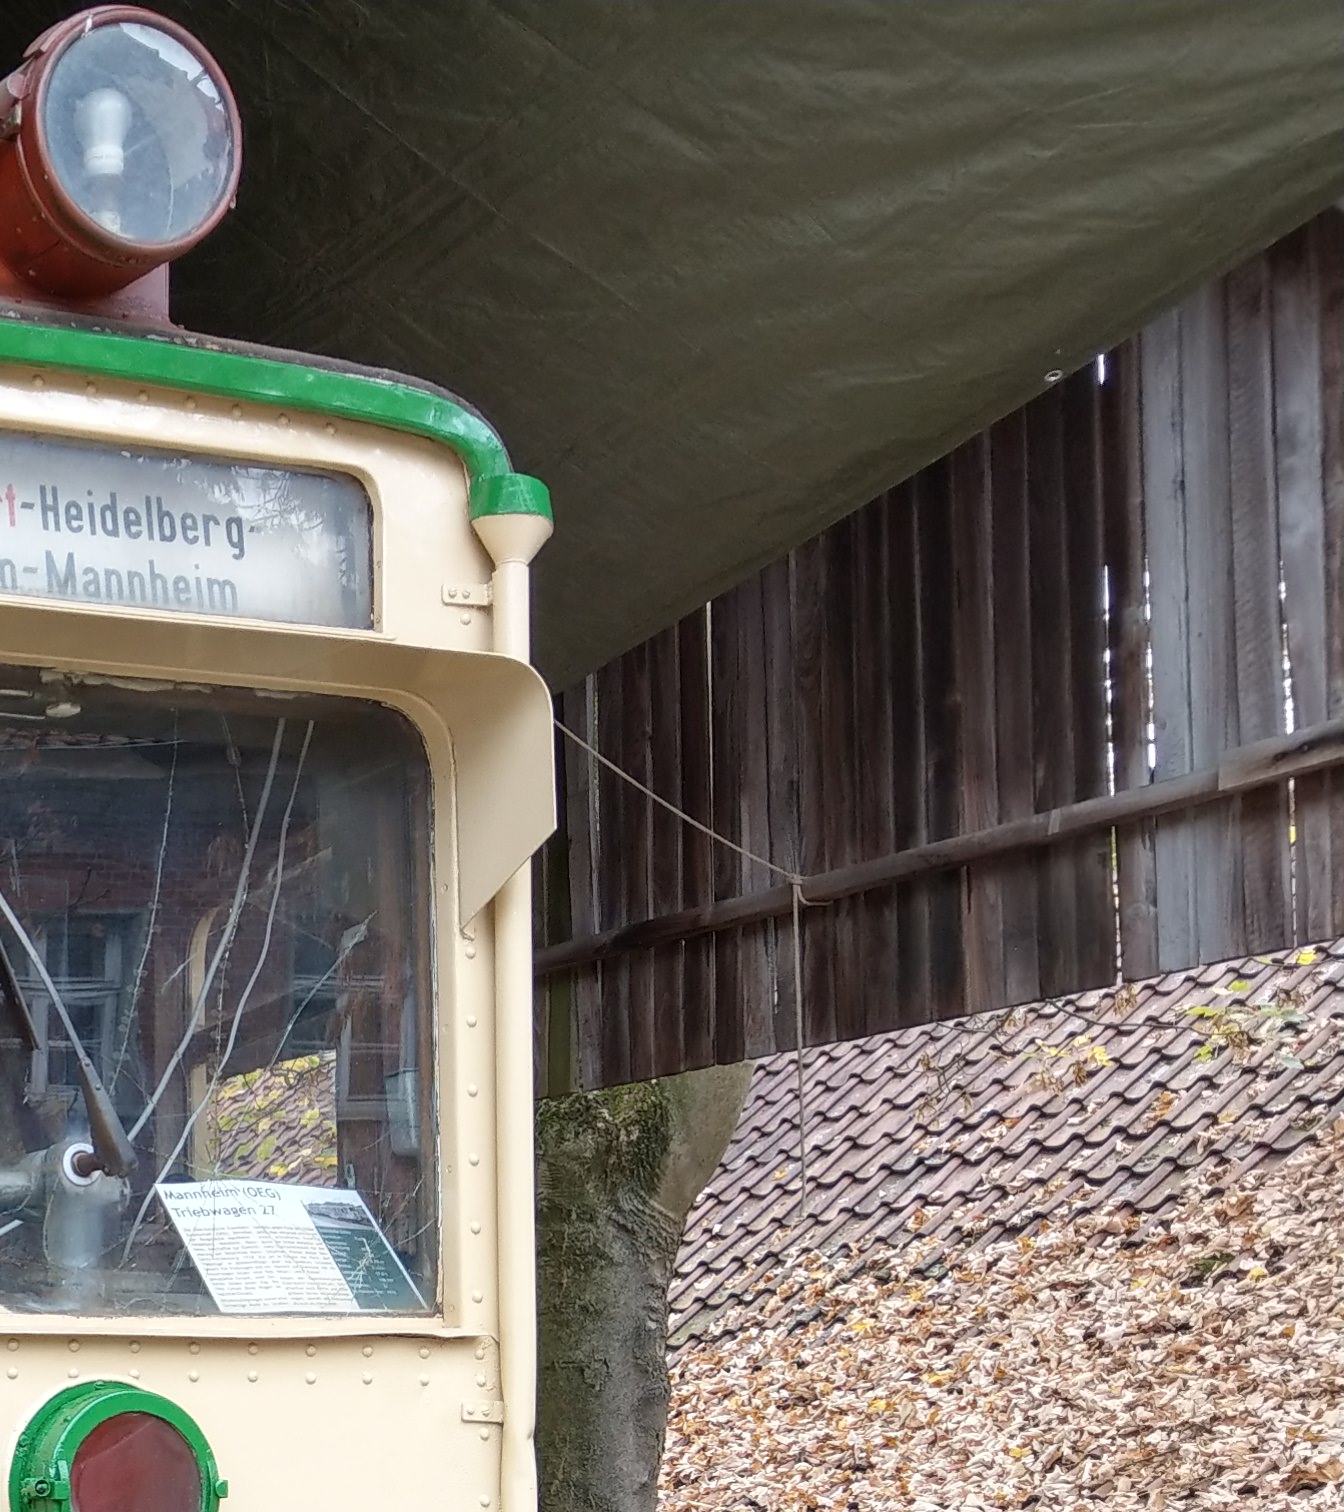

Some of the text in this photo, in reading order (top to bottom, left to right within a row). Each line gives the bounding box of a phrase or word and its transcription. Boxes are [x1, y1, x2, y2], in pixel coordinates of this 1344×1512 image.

[164, 1186, 281, 1201] Mannheim (OEG)
[171, 1204, 275, 1218] Triebwagen 27
